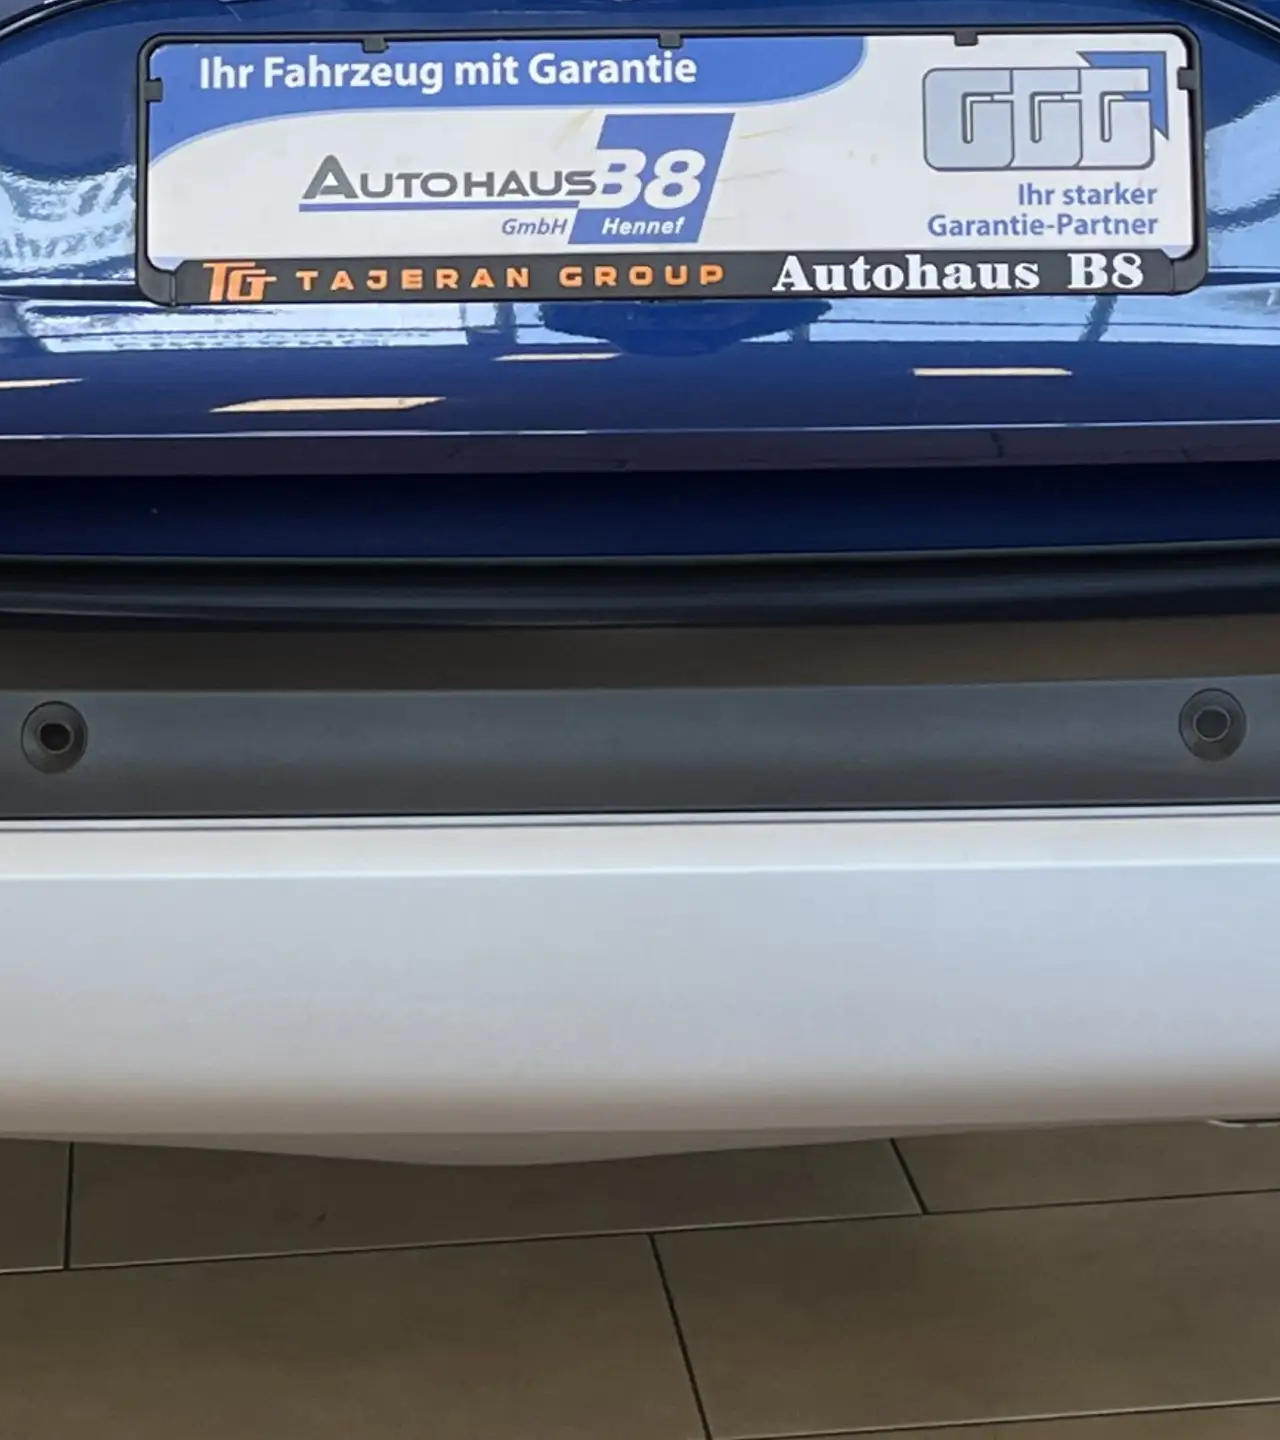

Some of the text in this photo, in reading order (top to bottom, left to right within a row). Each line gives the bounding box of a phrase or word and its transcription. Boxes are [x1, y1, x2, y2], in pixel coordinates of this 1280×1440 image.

[199, 50, 698, 95] Ihr Fahrzeug mit Garantie
[596, 148, 706, 210] B8
[1018, 182, 1158, 206] Ihr starker
[502, 215, 686, 236] GmbH Hennef
[927, 214, 1159, 237] Garantie-Partner
[295, 268, 530, 292] TAJERAN
[559, 265, 725, 288] GROUP
[772, 253, 1144, 292] Autohaus B8
